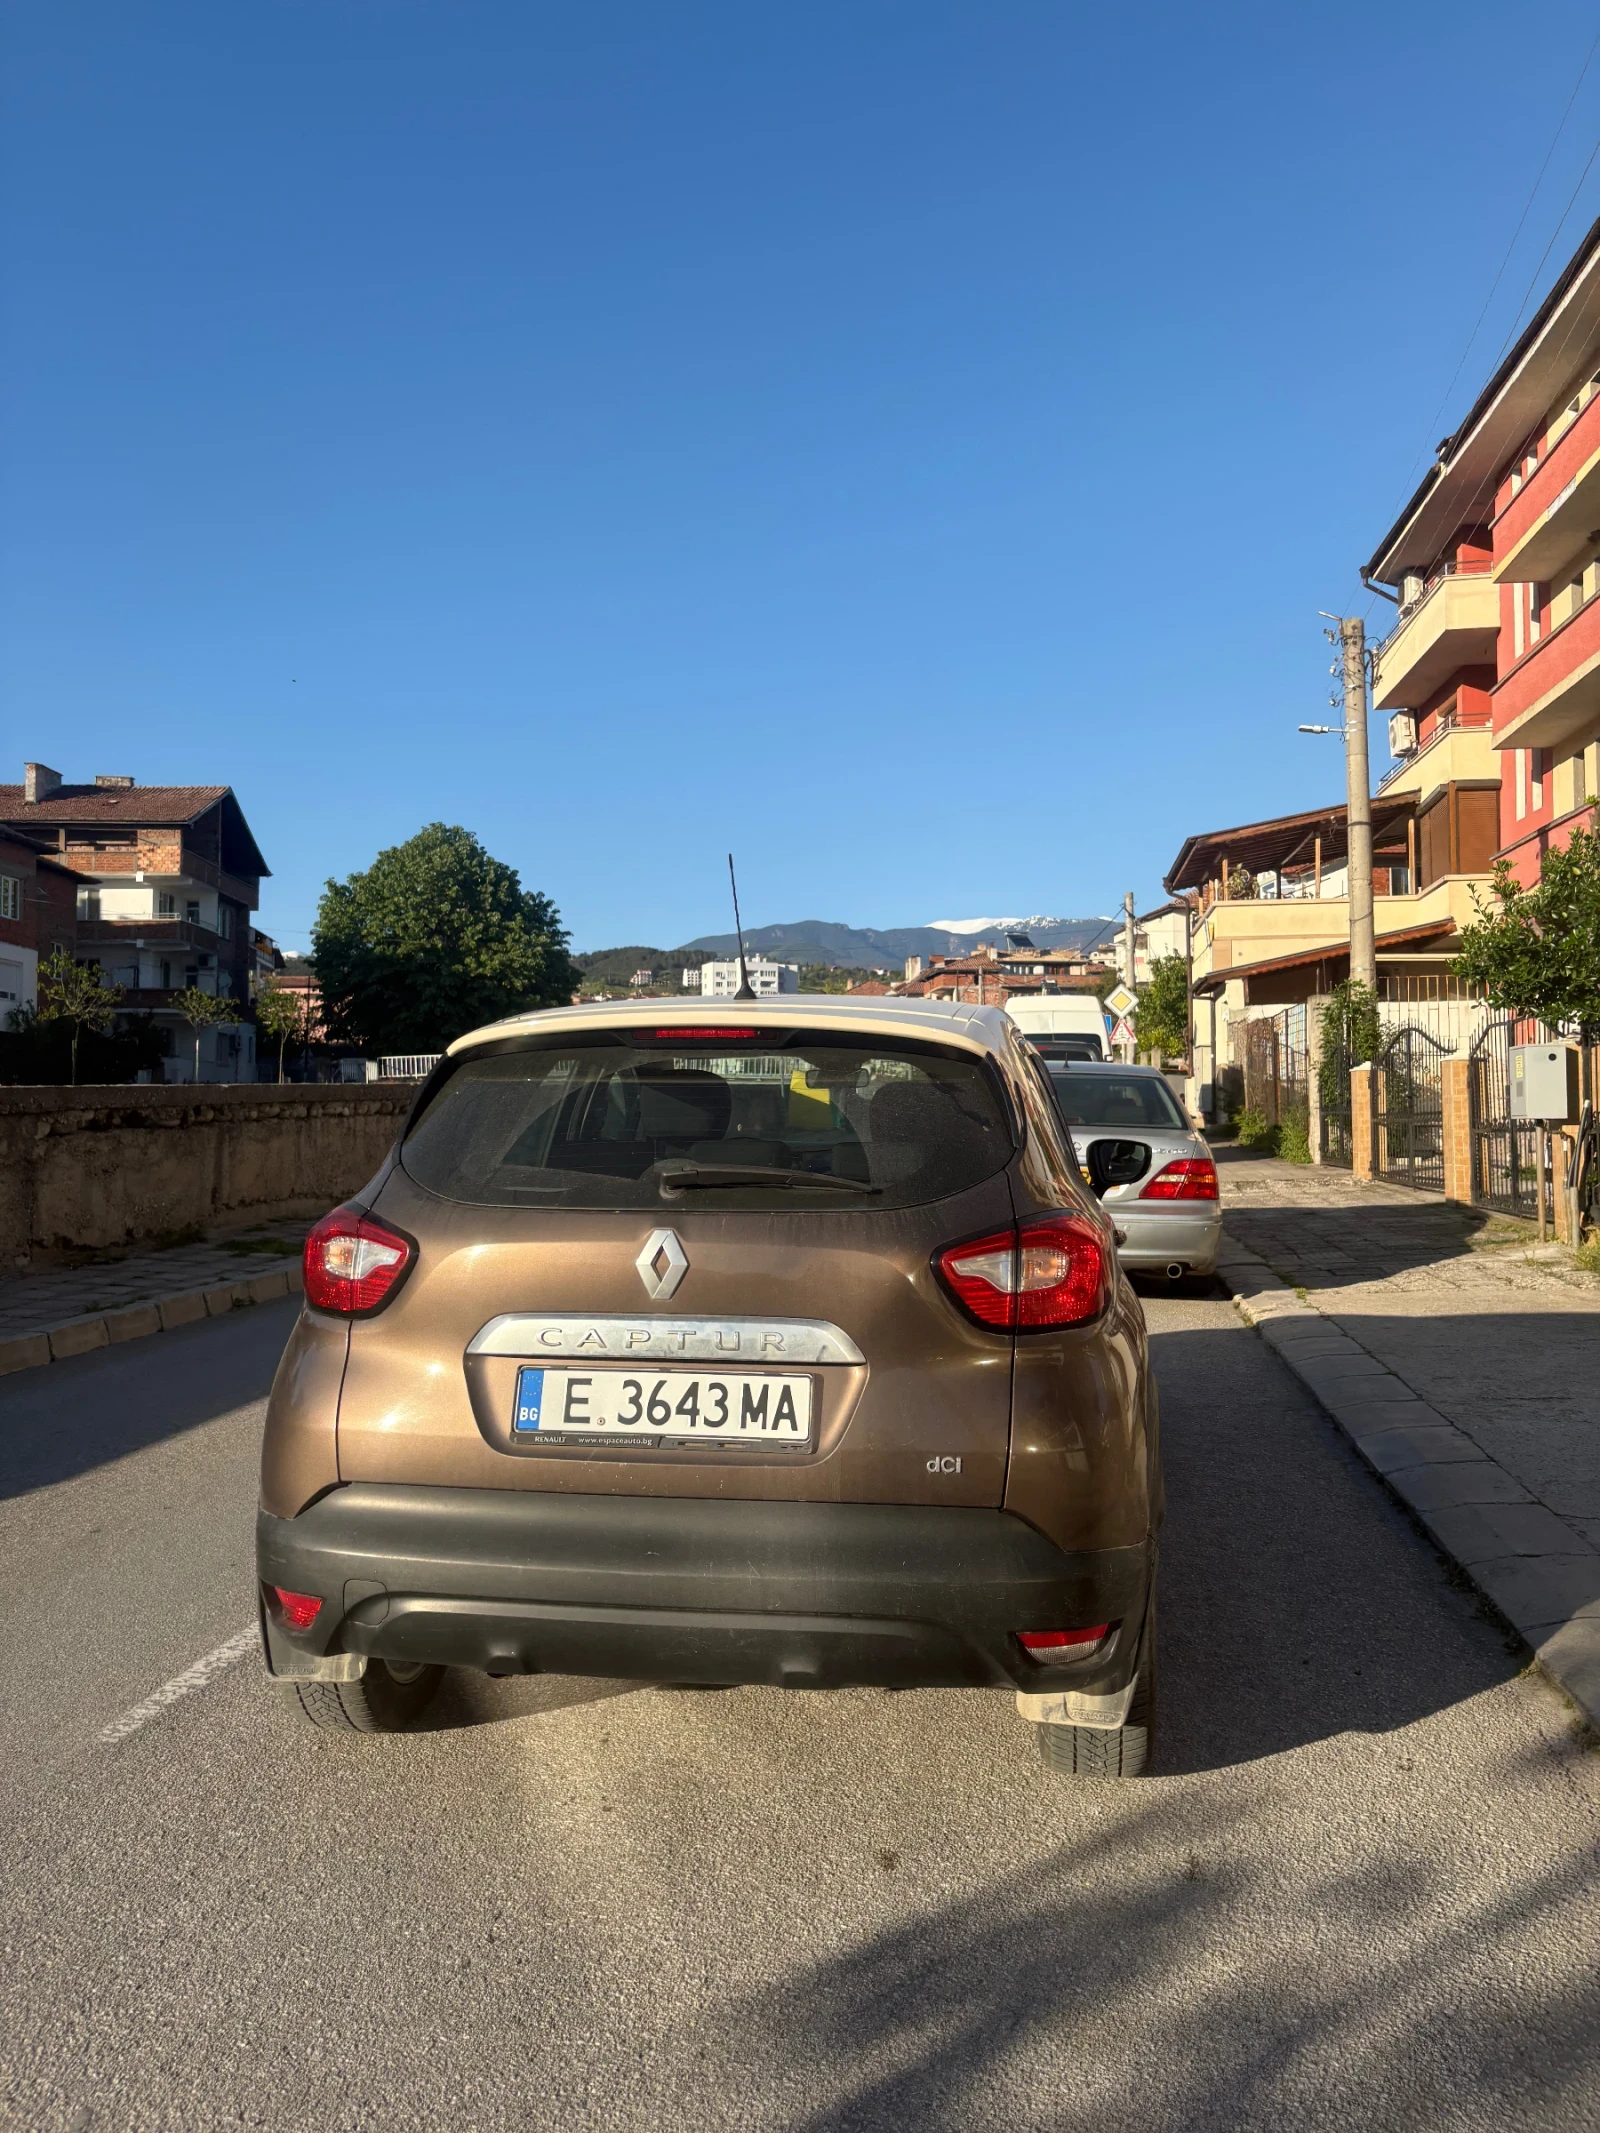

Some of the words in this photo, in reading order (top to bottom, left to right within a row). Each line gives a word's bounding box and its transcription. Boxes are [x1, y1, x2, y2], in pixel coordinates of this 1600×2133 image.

[536, 1327, 787, 1352] CAPTUR
[519, 1406, 539, 1421] BG
[563, 1377, 593, 1424] E
[617, 1379, 729, 1428] 3643
[740, 1382, 798, 1432] MA
[534, 1435, 567, 1444] RENAULT
[578, 1436, 653, 1447] www.espaceauto.bg
